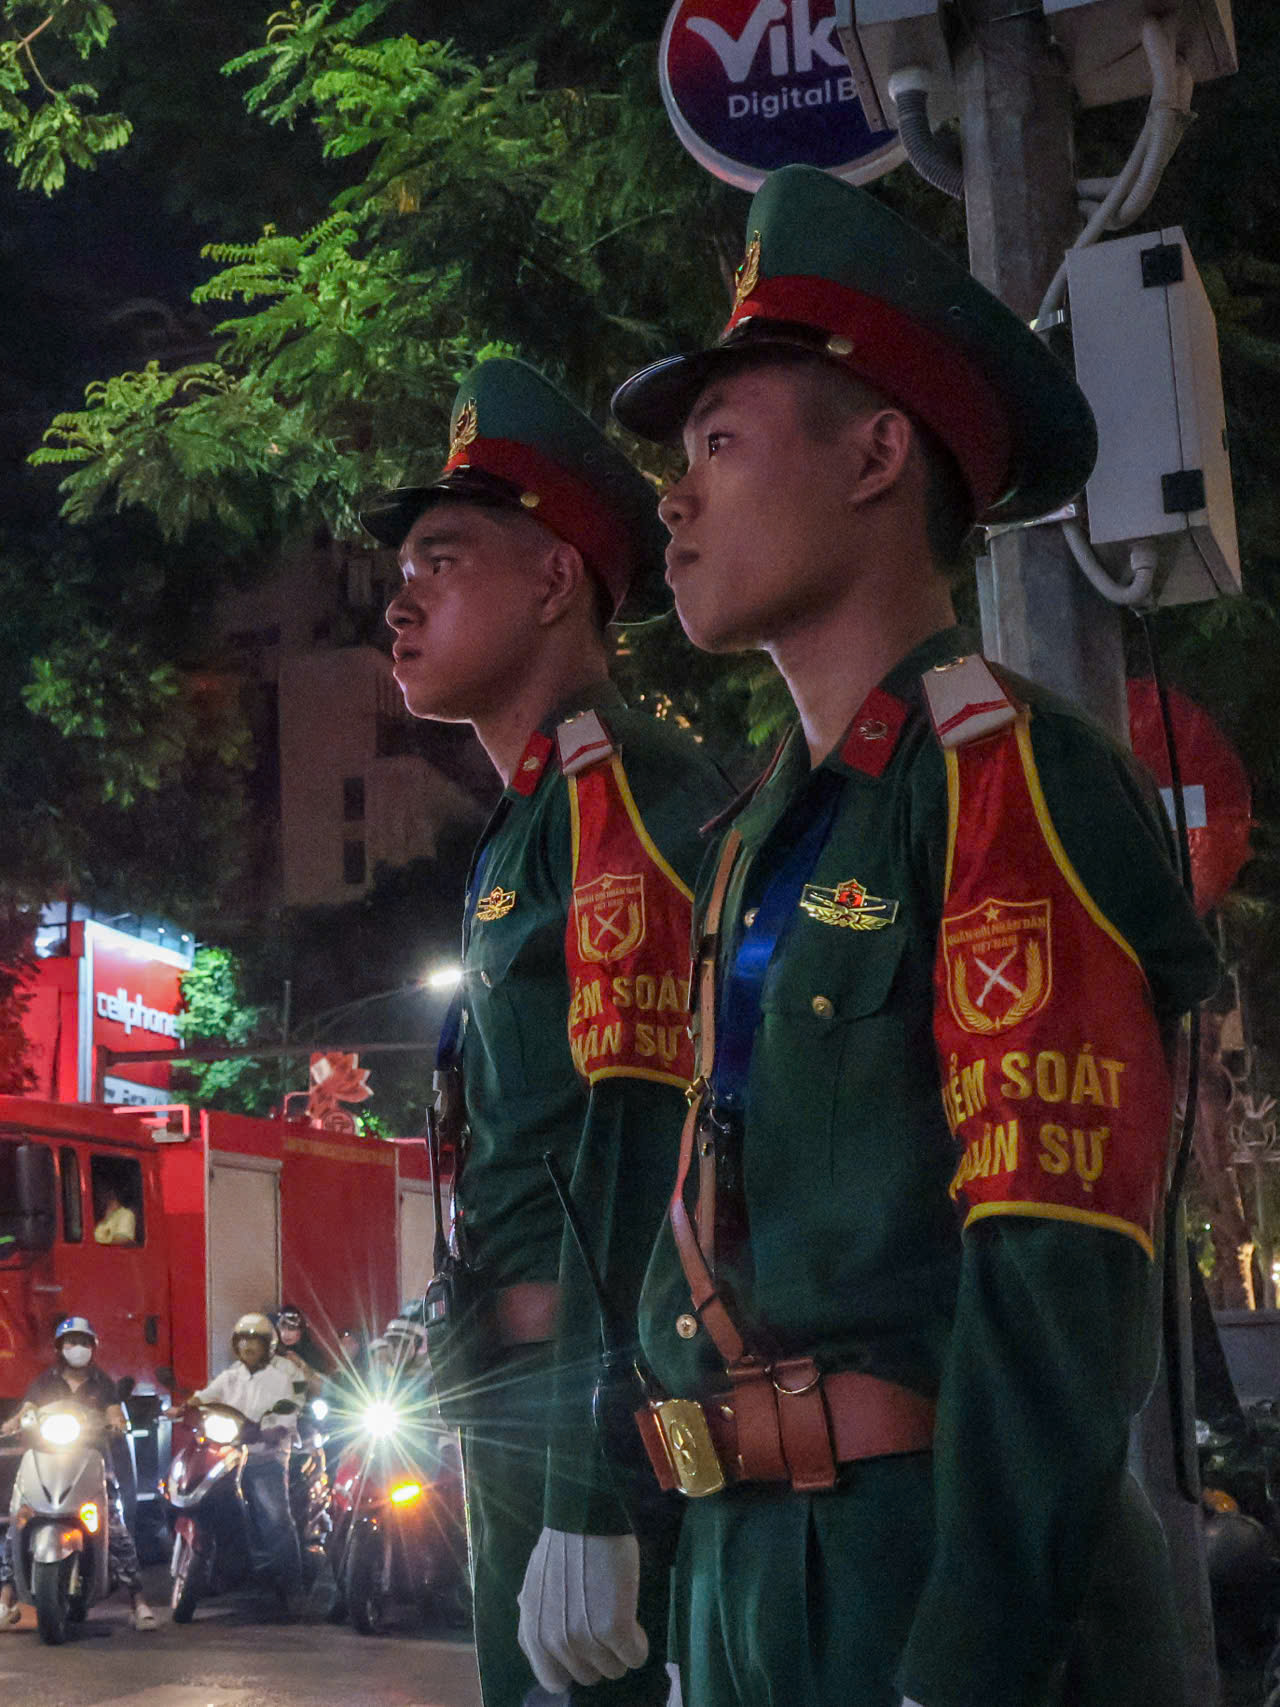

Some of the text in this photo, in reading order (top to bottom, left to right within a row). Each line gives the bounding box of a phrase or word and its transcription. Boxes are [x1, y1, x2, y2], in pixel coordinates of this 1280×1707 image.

[728, 80, 831, 118] Digital
[1000, 1043, 1126, 1108] SOÁT
[1039, 1123, 1110, 1192] SỰ
